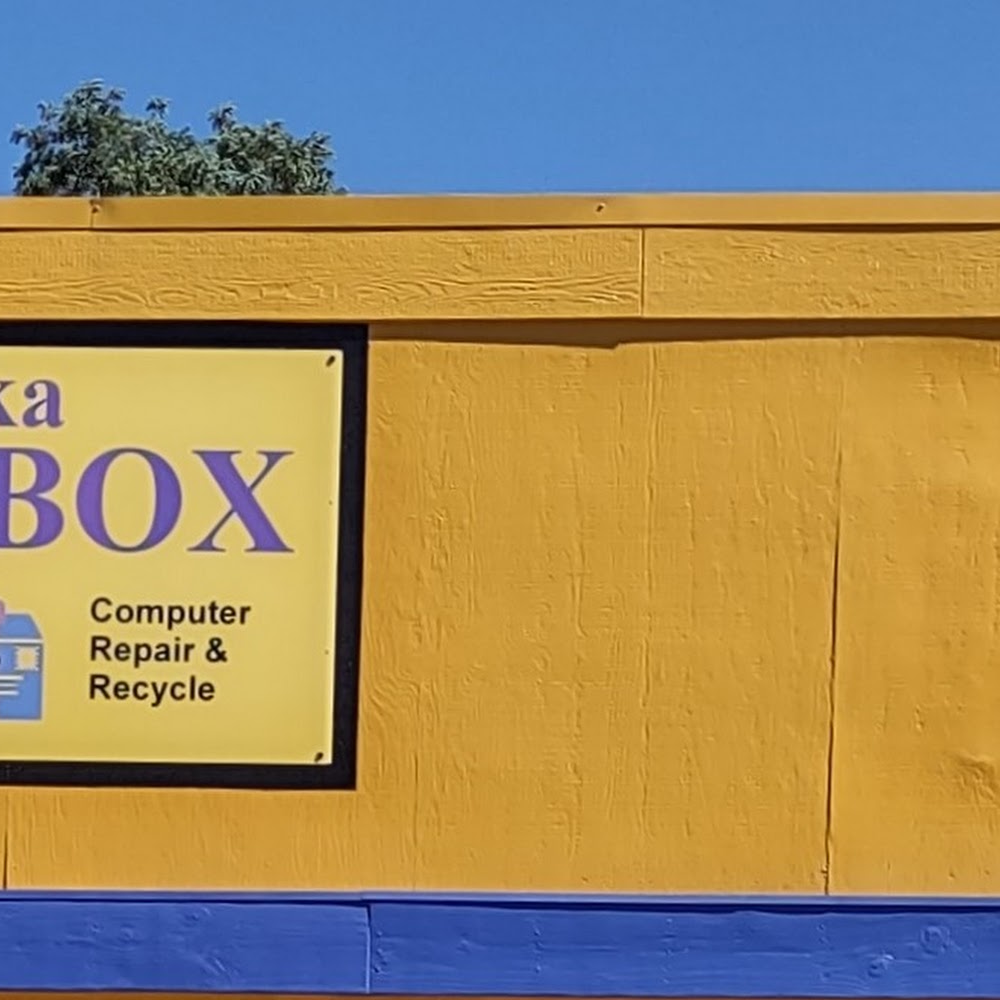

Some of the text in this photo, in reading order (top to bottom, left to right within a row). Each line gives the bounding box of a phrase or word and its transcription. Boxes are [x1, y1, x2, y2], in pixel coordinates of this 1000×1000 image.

[89, 597, 252, 632] Computer
[90, 637, 228, 670] Repair &
[89, 674, 217, 706] Recycle
